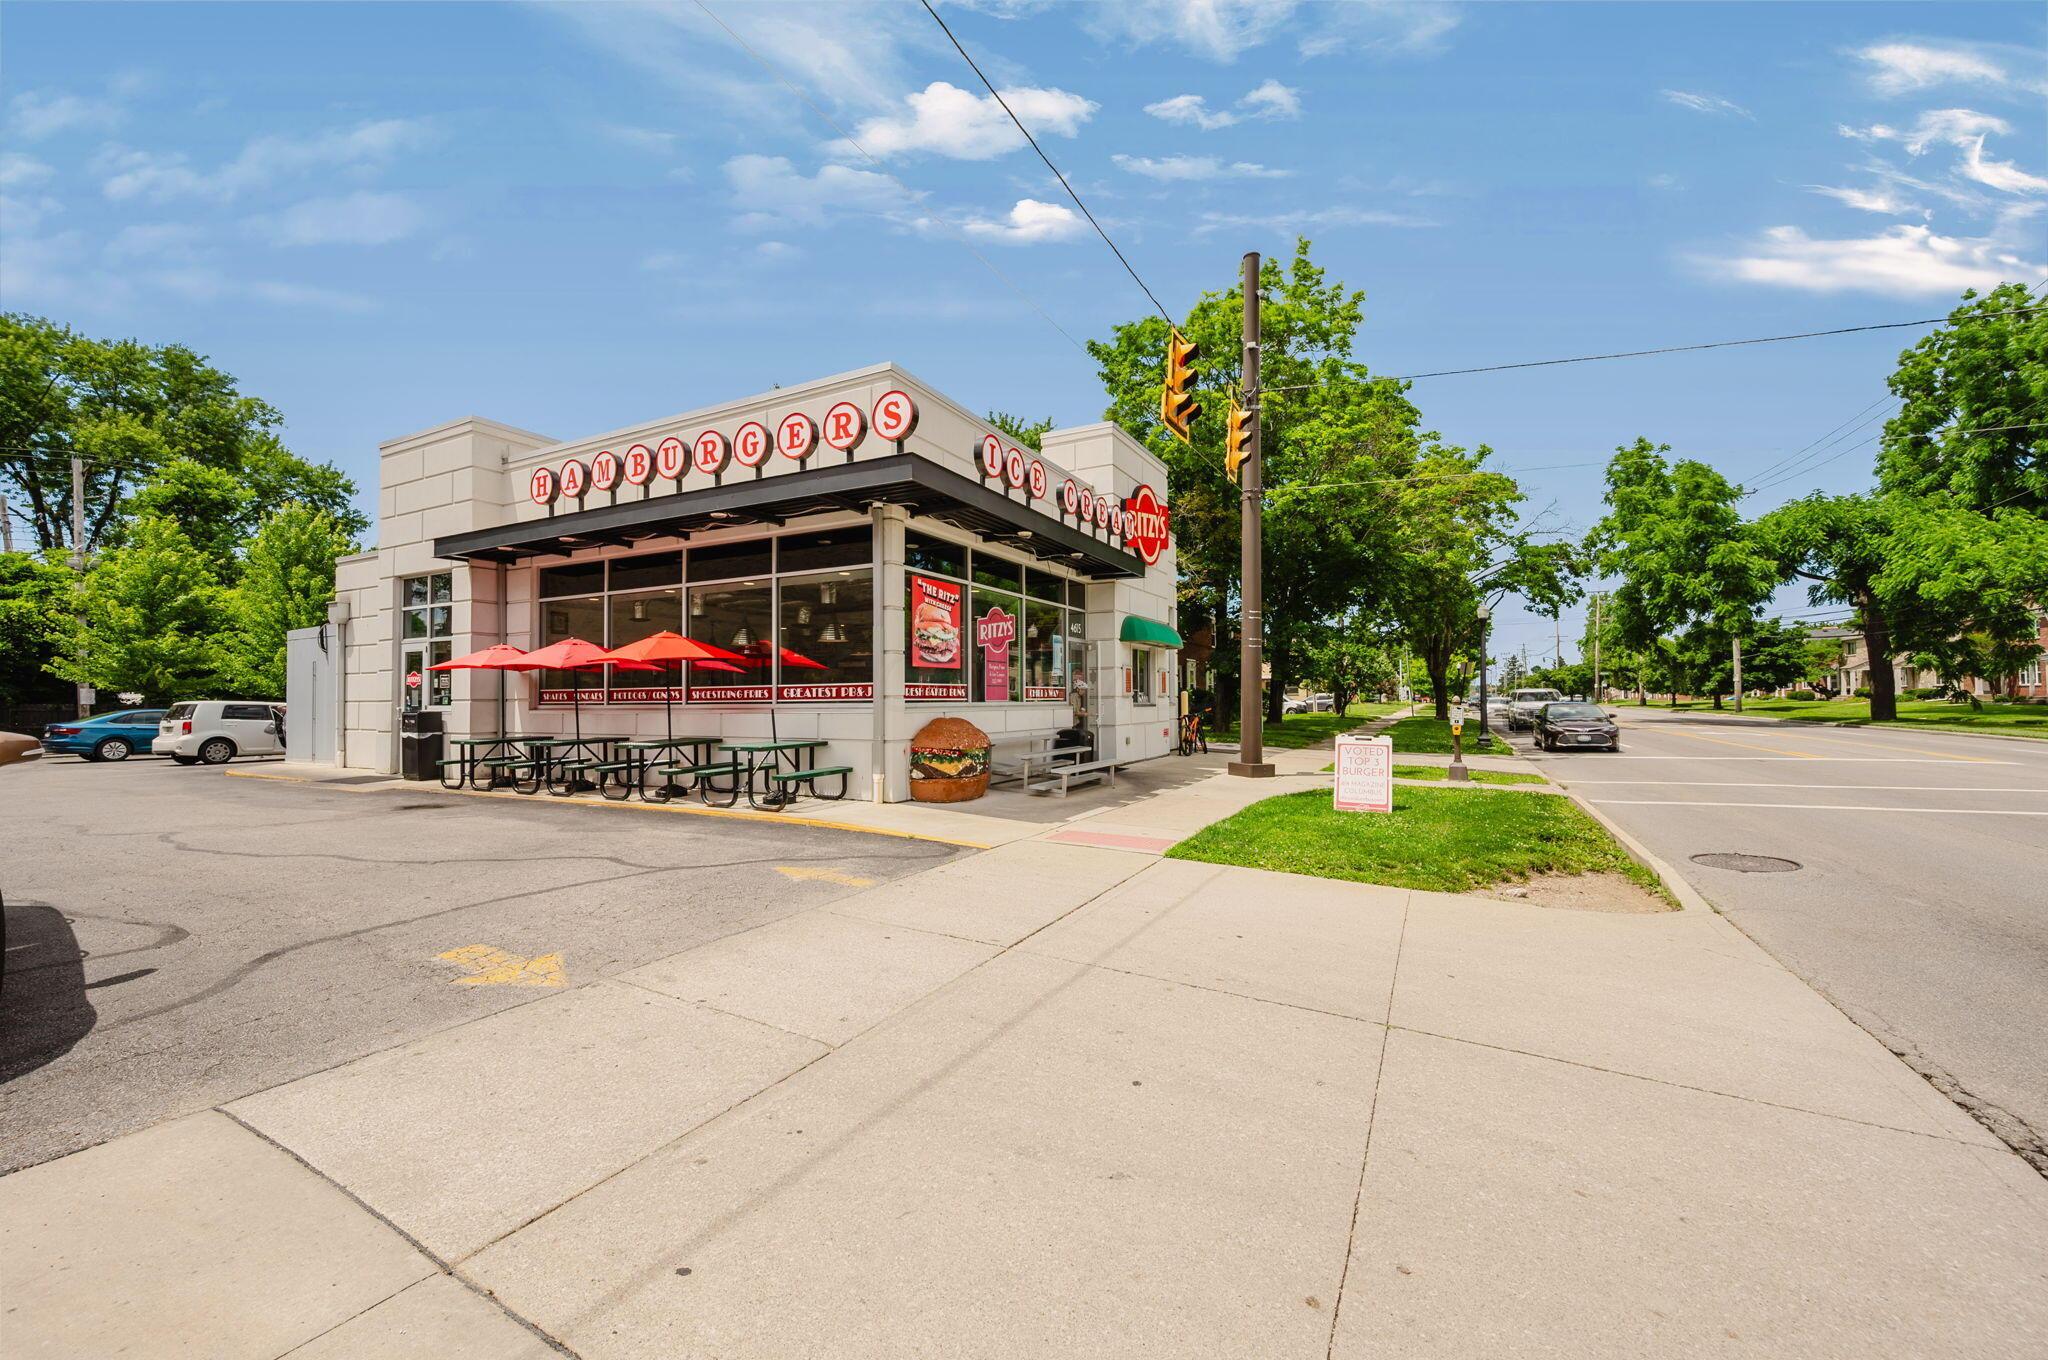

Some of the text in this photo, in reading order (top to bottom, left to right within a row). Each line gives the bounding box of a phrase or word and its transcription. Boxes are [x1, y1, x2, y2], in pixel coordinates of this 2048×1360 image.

[534, 399, 903, 499] HAMBURGERS
[988, 442, 1136, 538] ICE CREAM
[980, 615, 1013, 640] RITZY'S
[652, 691, 680, 700] CONYS
[691, 689, 769, 699] SHOESTRING FRIES
[783, 687, 837, 698] GREATEST
[905, 687, 924, 697] RESH
[949, 688, 966, 697] BUNS
[1344, 746, 1384, 756] VOTED
[1345, 757, 1380, 767] TOP 3
[1342, 767, 1385, 777] BURGER
